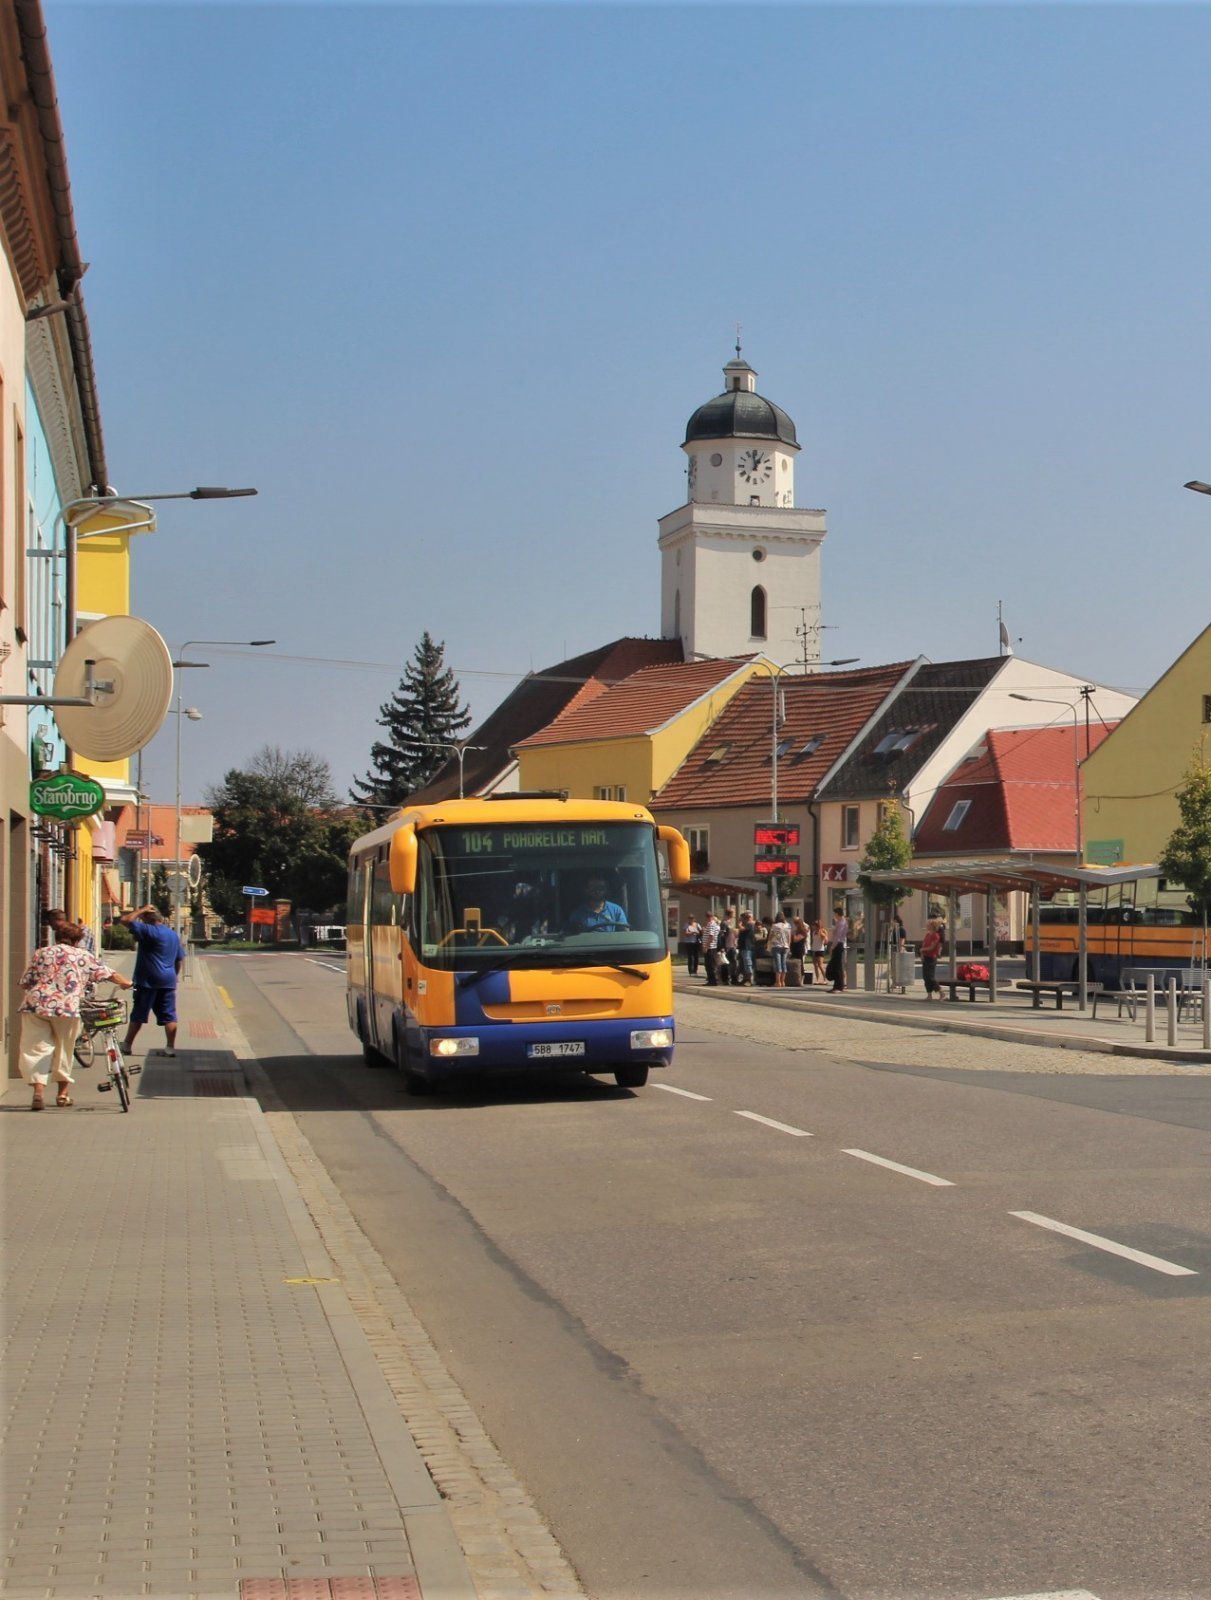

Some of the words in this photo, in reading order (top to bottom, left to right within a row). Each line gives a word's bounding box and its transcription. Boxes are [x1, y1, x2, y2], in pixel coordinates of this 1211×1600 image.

[34, 784, 98, 809] Starobrno
[462, 831, 493, 853] 104
[503, 831, 576, 849] POHORELICE
[534, 1045, 552, 1055] 5B8
[559, 1043, 581, 1054] 1747
